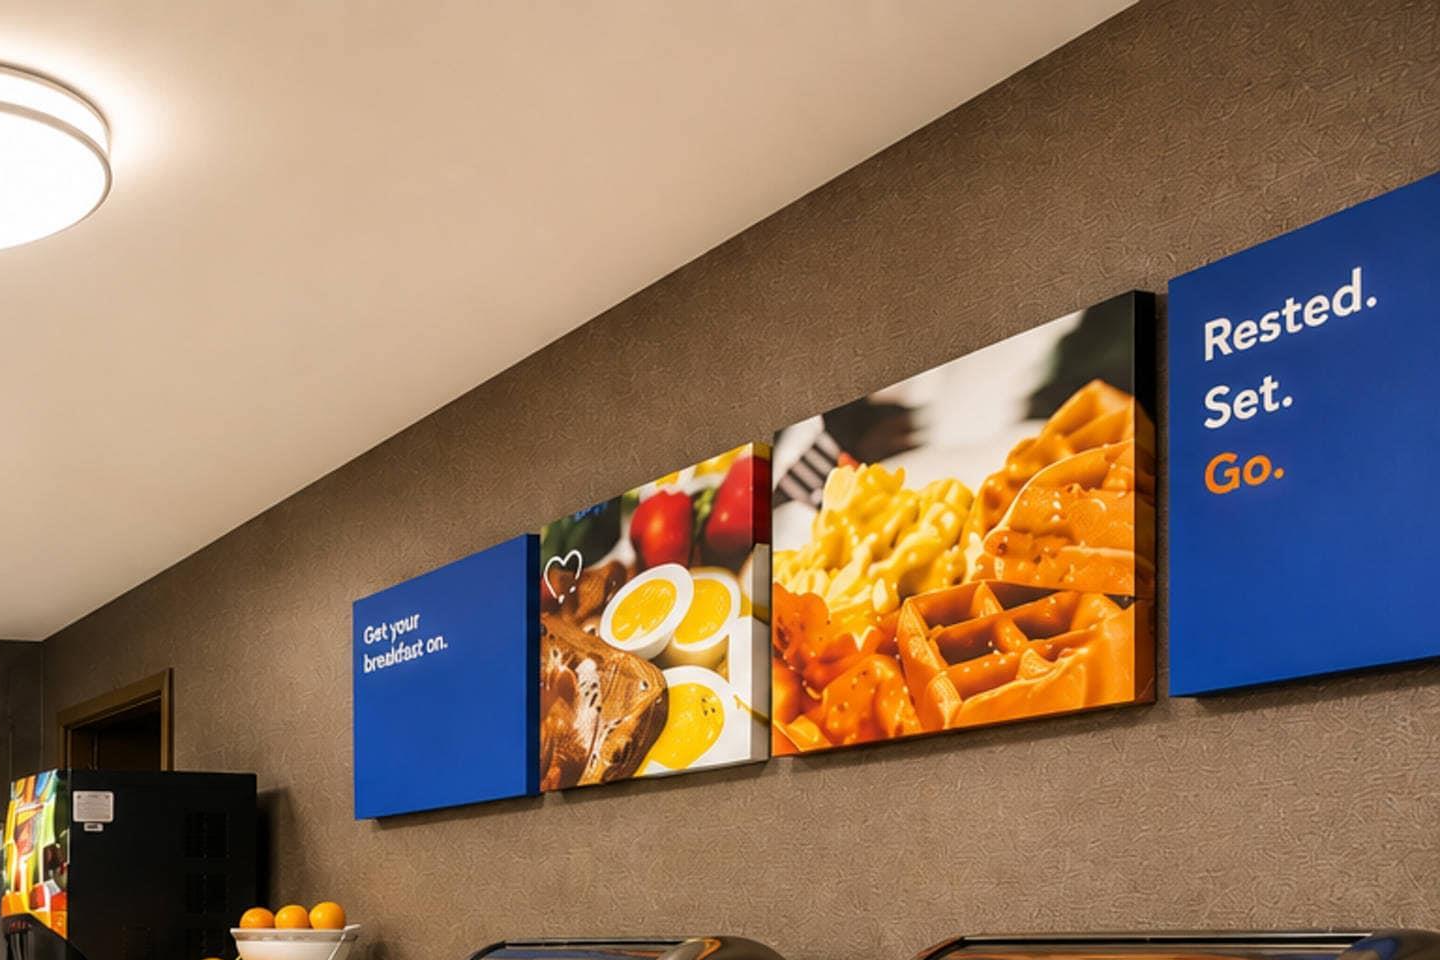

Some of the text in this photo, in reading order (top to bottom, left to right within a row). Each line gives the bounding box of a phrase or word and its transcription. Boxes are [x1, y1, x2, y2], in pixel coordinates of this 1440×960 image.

[1204, 266, 1378, 362] Rested.
[1203, 375, 1294, 430] Set.
[1204, 451, 1285, 495] Go.
[363, 613, 421, 645] Get your
[426, 635, 448, 654] on.
